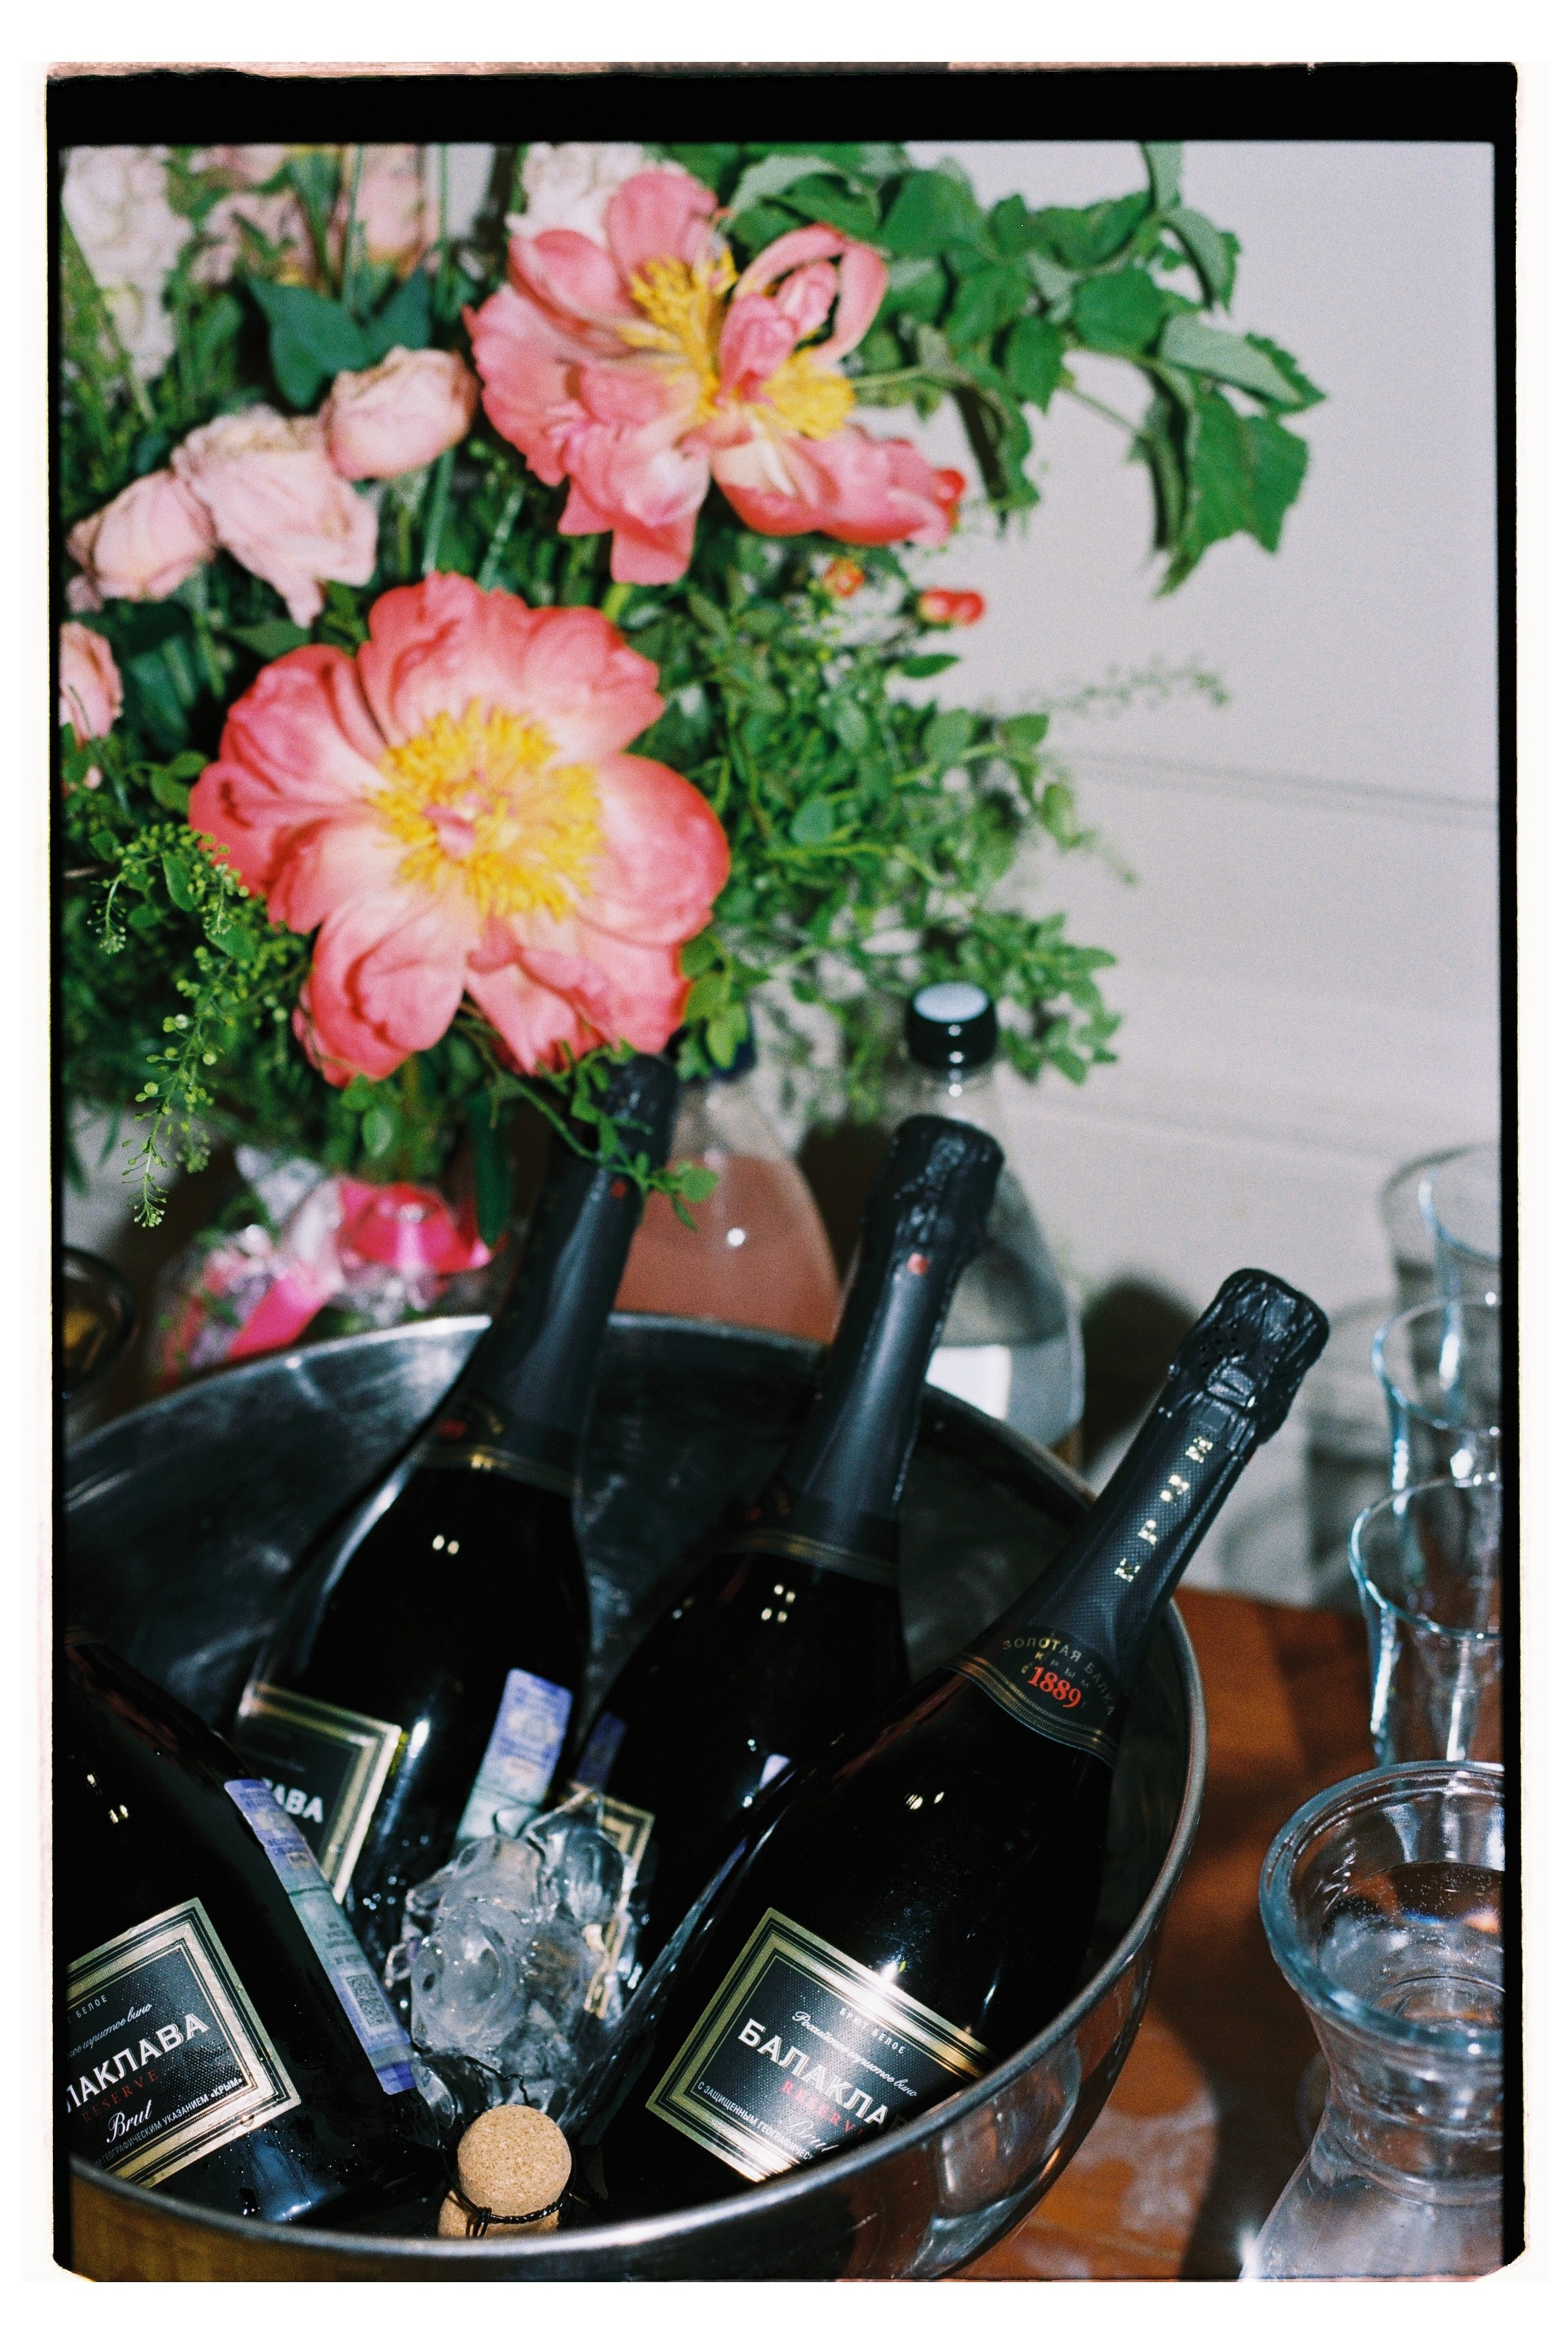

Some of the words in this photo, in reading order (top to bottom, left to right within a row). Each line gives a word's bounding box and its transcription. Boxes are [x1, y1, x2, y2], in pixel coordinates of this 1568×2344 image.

[1003, 1637, 1083, 1663] ЗОЛОТАЯ
[1027, 1666, 1082, 1708] 1889
[75, 1994, 108, 2019] БЕЛОЕ
[128, 2003, 153, 2022] вино
[839, 2007, 869, 2030] БРЮТ
[872, 2028, 906, 2055] БЕЛОЕ
[66, 2013, 211, 2114] ЛАКЛАВА
[81, 2069, 159, 2124] RESERVE
[697, 2081, 704, 2091] С
[704, 2085, 759, 2126] ЗАЩИЩЕННЫМ
[894, 2078, 918, 2097] вино
[101, 2121, 162, 2164] ГЕОГРАФИЧЕСКИМ
[161, 2094, 209, 2126] УКАЗАНИЕМ
[209, 2077, 243, 2099] «КРЫМ»
[106, 2099, 153, 2144] Brut
[779, 2113, 840, 2153] Brut
